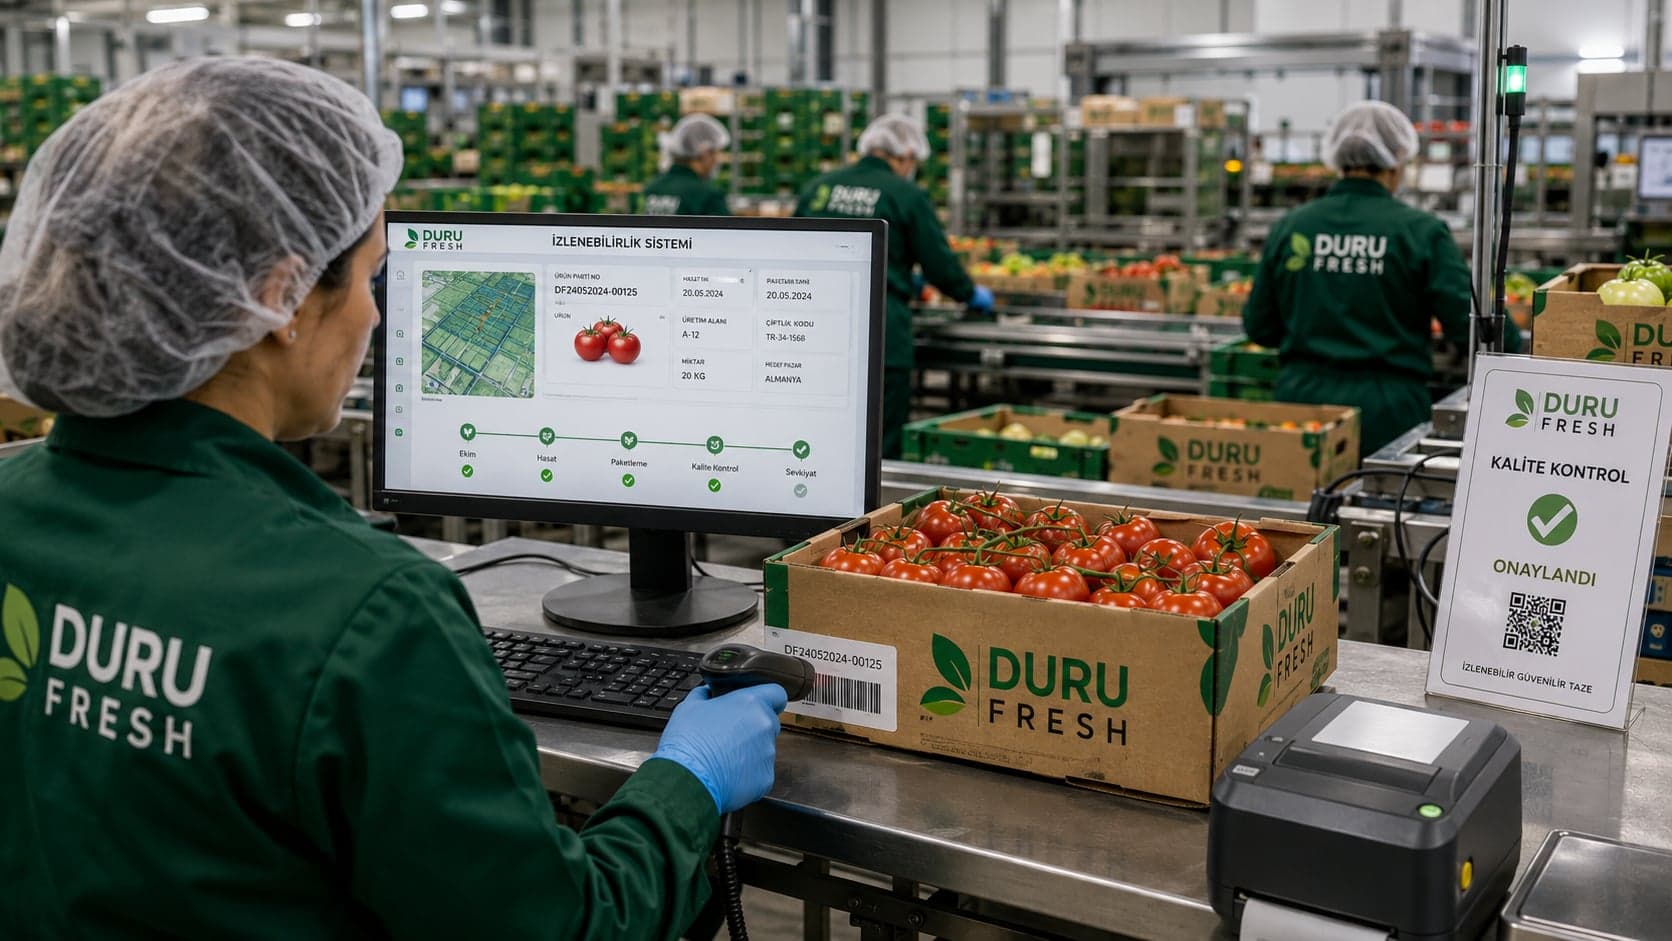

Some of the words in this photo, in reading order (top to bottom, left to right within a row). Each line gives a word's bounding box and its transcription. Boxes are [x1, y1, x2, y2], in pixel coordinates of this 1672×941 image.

[423, 229, 462, 241] DURU
[552, 234, 641, 248] İZLENEBİLİRLİK
[645, 236, 692, 250] SİSTEMİ
[1313, 232, 1388, 258] DURU
[422, 242, 462, 250] FRESH
[1312, 253, 1385, 275] FRESH
[682, 289, 724, 298] 20.05.2024
[766, 291, 812, 300] 20.05.2024
[682, 331, 700, 339] A-12
[1632, 351, 1672, 366] FR
[682, 372, 692, 380] 20
[694, 372, 706, 380] KG
[765, 375, 802, 384] ALMANYA
[1543, 392, 1619, 419] DURU
[1541, 417, 1616, 437] FRESH
[459, 450, 477, 458] Ekim
[537, 454, 557, 463] Hasat
[1188, 440, 1261, 465] DURU
[691, 462, 714, 471] Kalite
[714, 463, 739, 473] Kontrol
[785, 468, 817, 479] Sevkiyat
[1187, 465, 1260, 483] FRESH
[1491, 455, 1546, 475] KALİTE
[1550, 462, 1630, 484] KONTROL
[1493, 558, 1597, 587] ONAYLANDI
[1278, 582, 1315, 654] DURU
[48, 602, 213, 708] DURU
[784, 644, 882, 670] DF24052024-00125
[1276, 631, 1314, 689] FRESH
[988, 646, 1129, 708] DURU
[1462, 661, 1516, 681] İZLENEBİLİR
[1517, 671, 1566, 689] GÜVENİLİR
[1569, 681, 1593, 694] TAZE
[44, 676, 193, 760] FRESH
[988, 698, 1128, 746] FRESH
